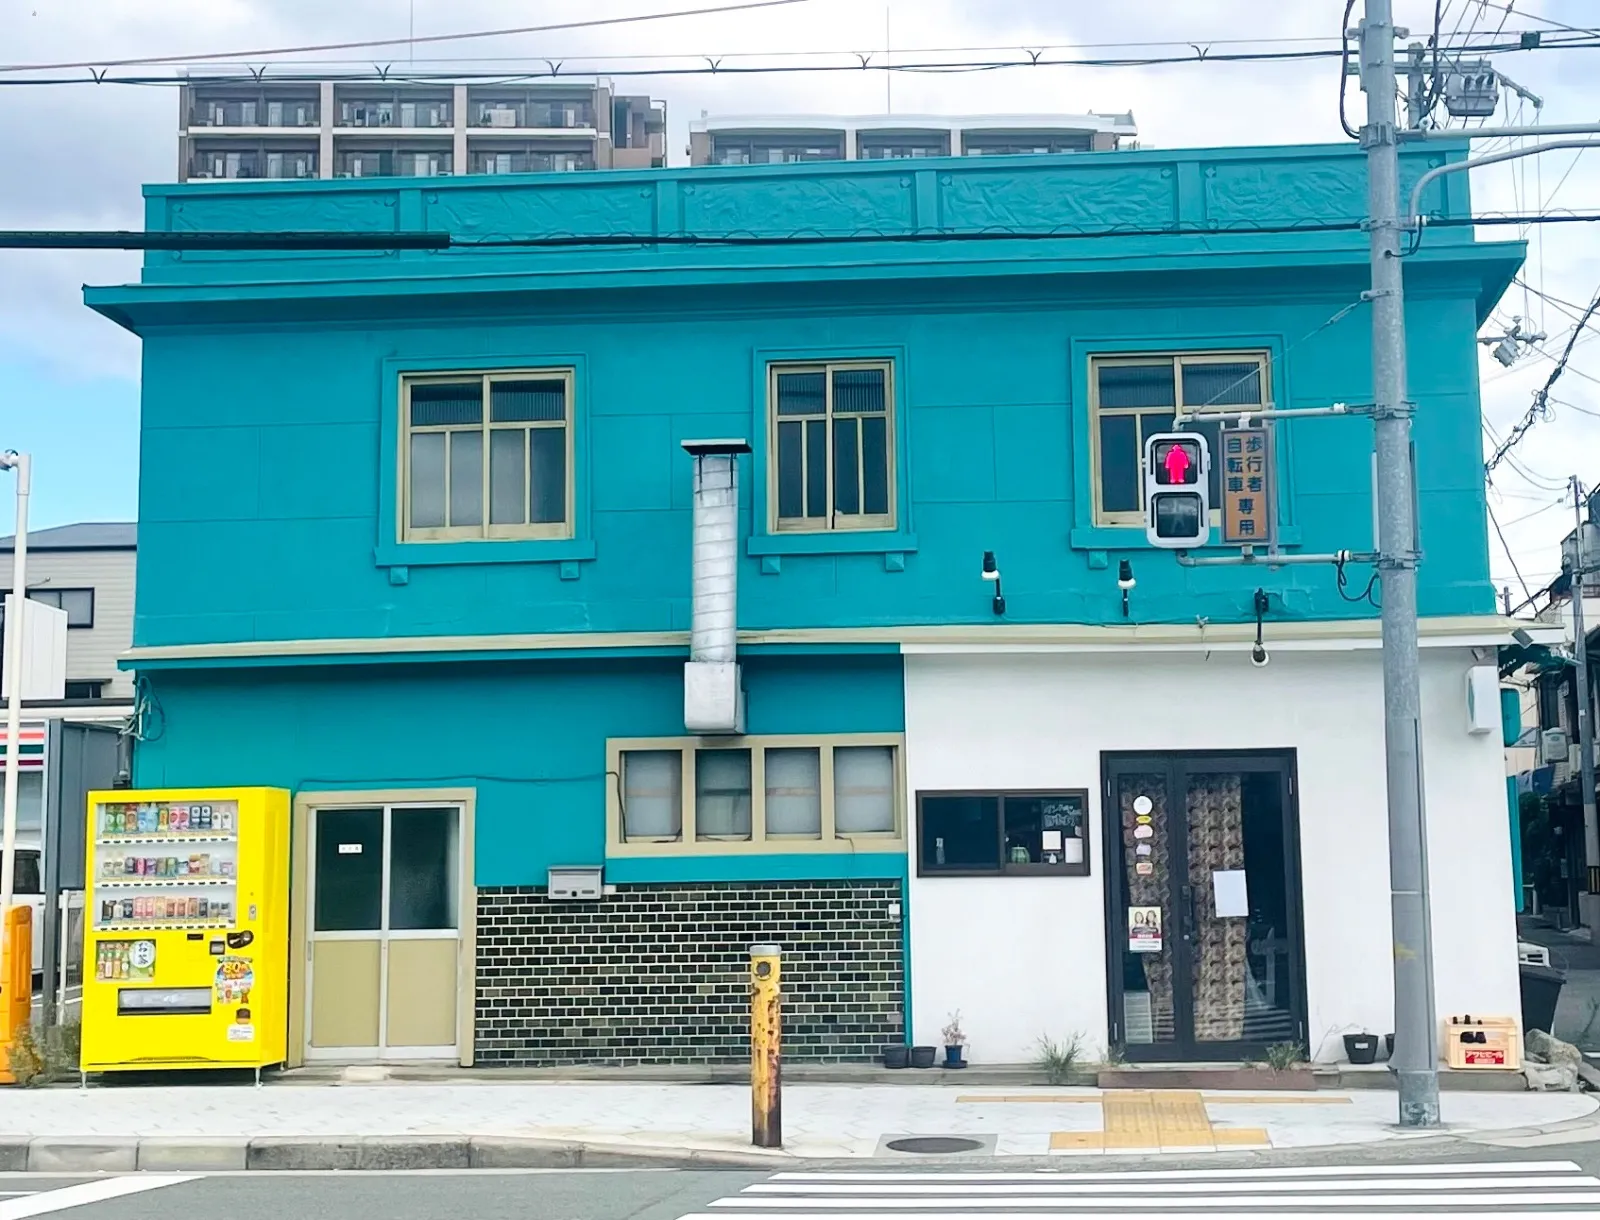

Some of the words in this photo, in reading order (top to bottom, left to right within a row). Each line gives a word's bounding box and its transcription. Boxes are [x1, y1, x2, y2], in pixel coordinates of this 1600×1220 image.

[1227, 437, 1244, 493] 自転車
[1246, 436, 1263, 492] 歩行者
[1238, 498, 1255, 536] 専用
[138, 942, 149, 964] お茶
